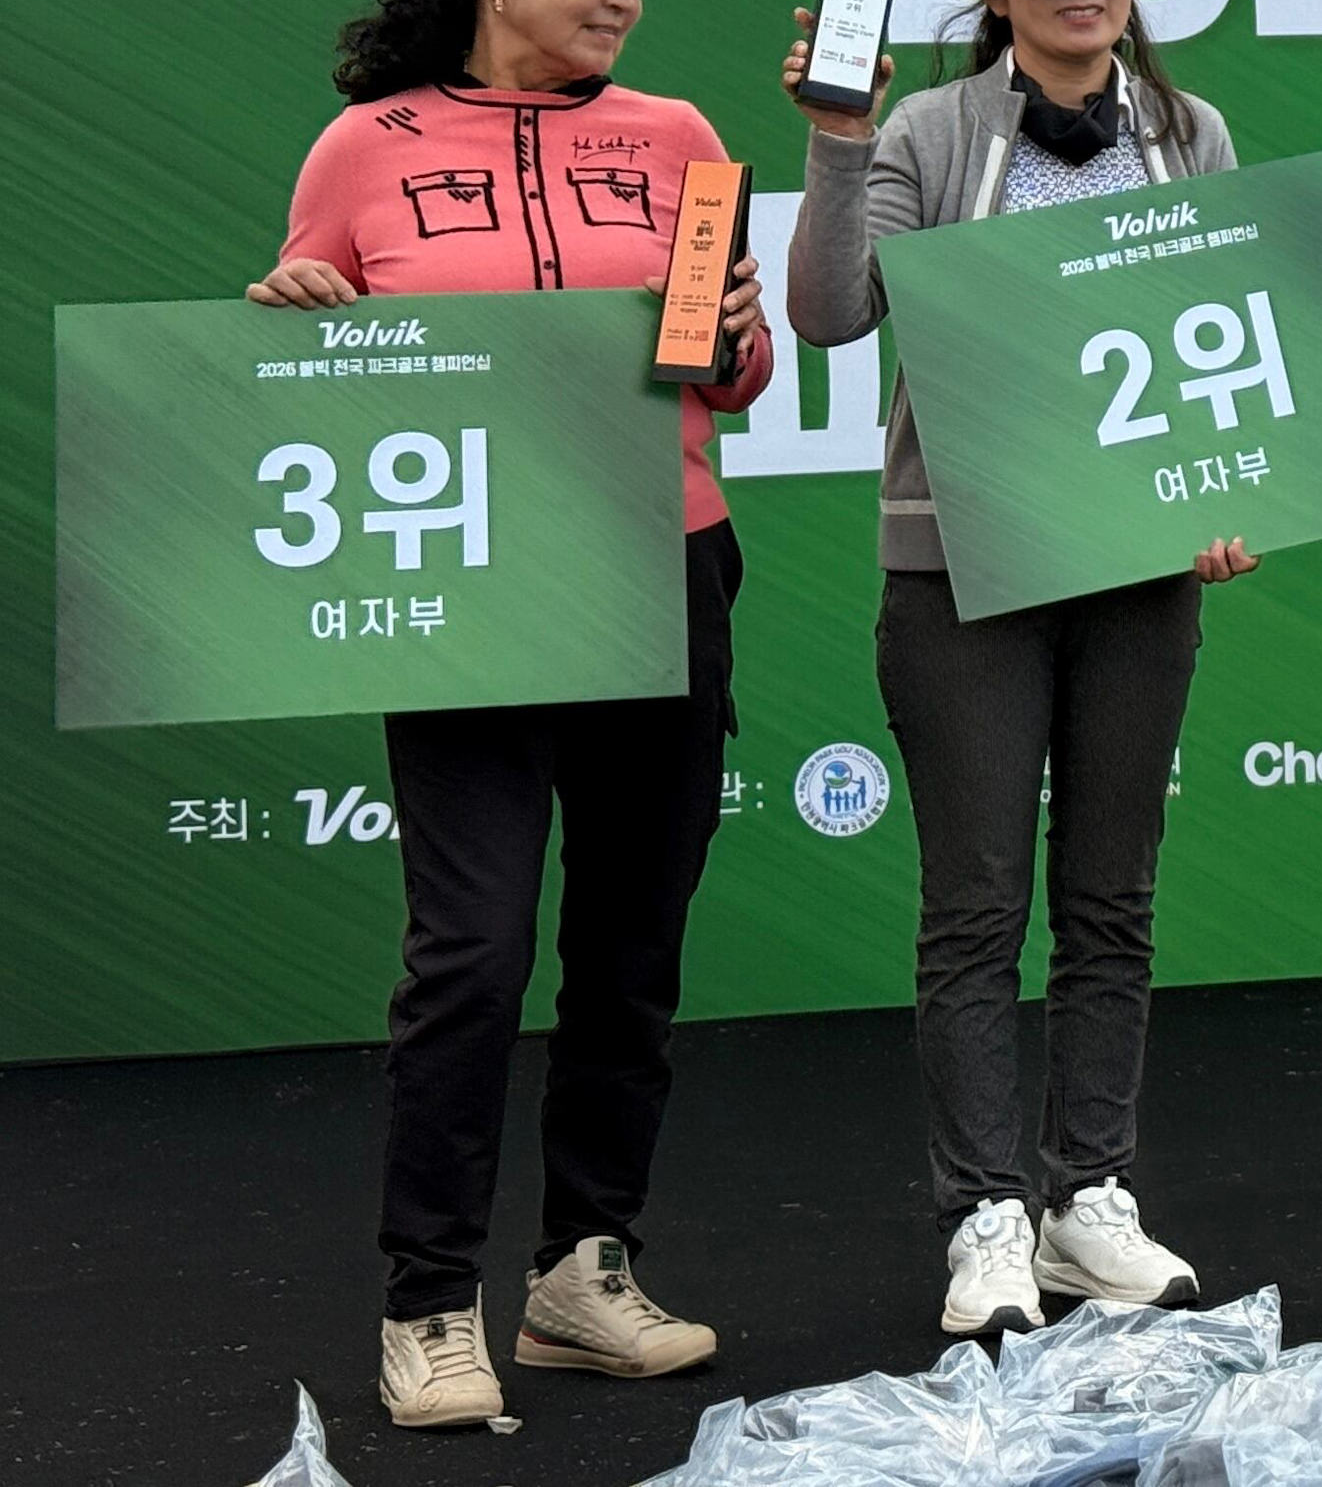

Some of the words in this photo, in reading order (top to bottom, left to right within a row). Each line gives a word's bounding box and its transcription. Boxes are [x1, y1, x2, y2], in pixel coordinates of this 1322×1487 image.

[1104, 201, 1199, 241] Volvik
[1059, 257, 1094, 277] 2026
[318, 318, 429, 349] Volvik
[256, 361, 296, 378] 2026
[333, 358, 364, 376] 전국
[367, 356, 428, 374] 파크골프
[432, 353, 491, 372] 챔피언십
[1080, 290, 1296, 448] 2위
[1154, 447, 1271, 503] 여자부
[254, 428, 490, 570] 3위
[310, 595, 446, 641] 여자부
[168, 797, 248, 844] 주최
